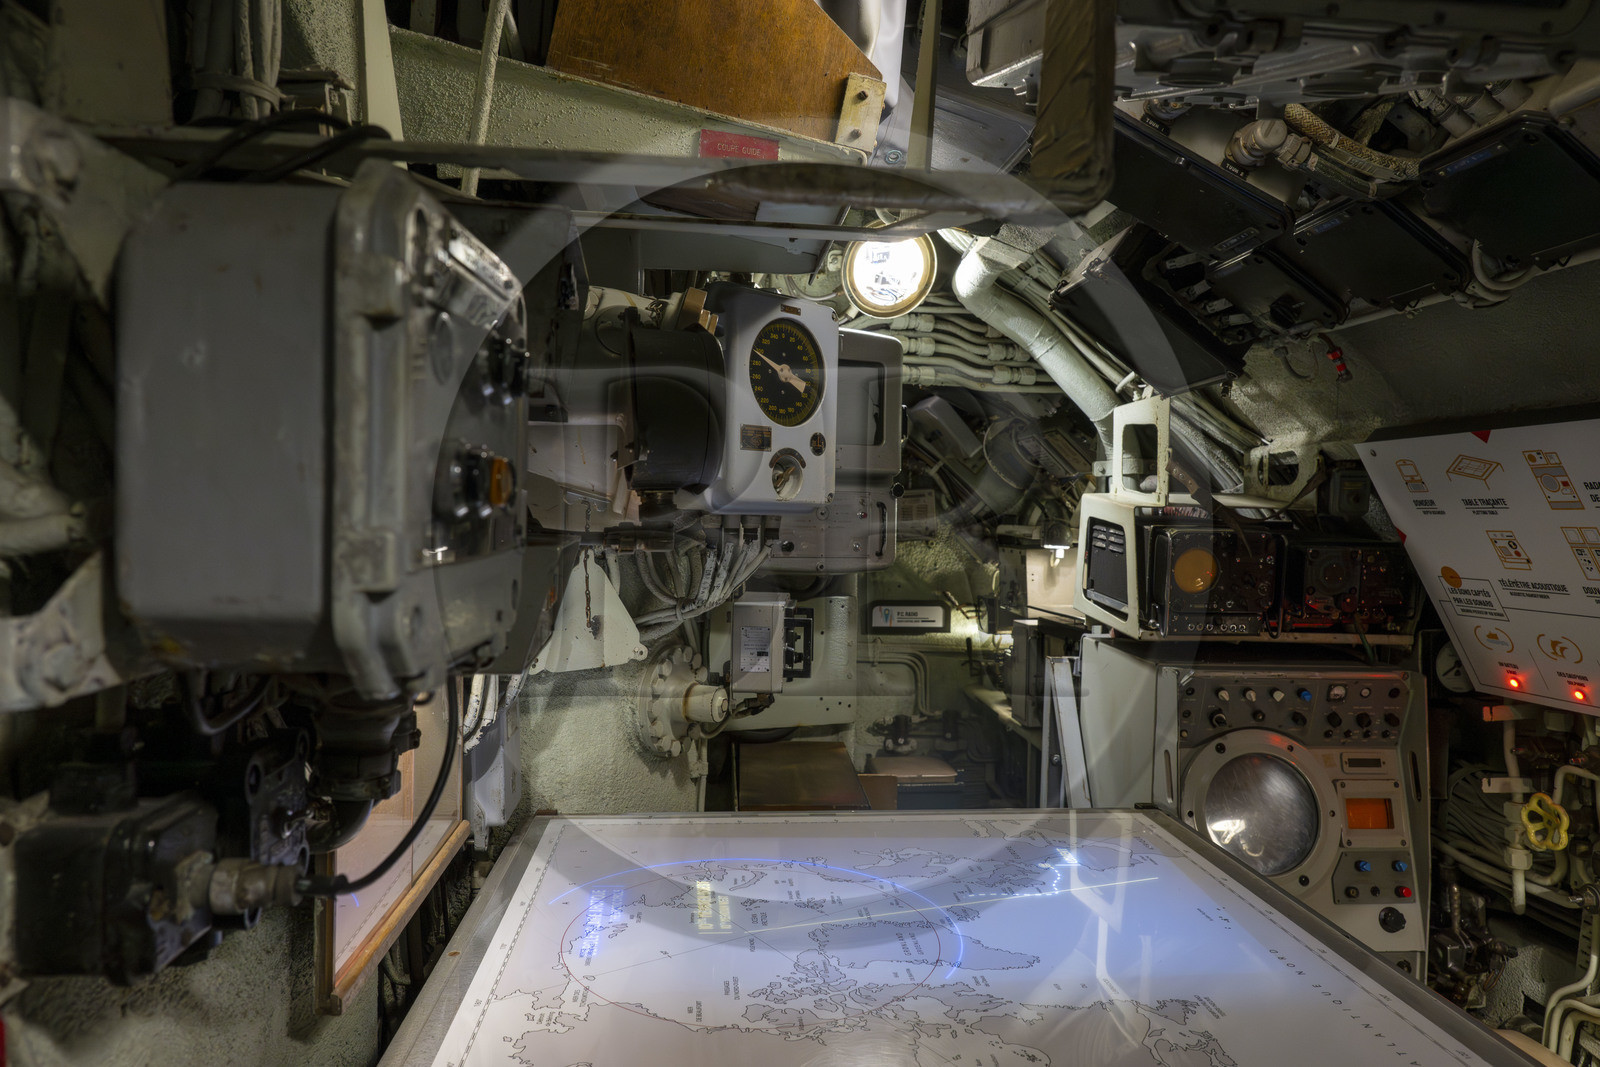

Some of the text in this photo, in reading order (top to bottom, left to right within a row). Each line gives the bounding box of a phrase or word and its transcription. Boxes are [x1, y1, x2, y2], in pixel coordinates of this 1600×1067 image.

[717, 143, 761, 156] COUPE GUIDE
[1461, 498, 1507, 509] TABLE TRAÇANTE
[1498, 579, 1569, 593] TÉLÉMÈTRE ACOUSTIQUE
[1447, 587, 1458, 595] LES
[1471, 589, 1491, 598] CAPTÉS
[1453, 596, 1463, 604] PAR
